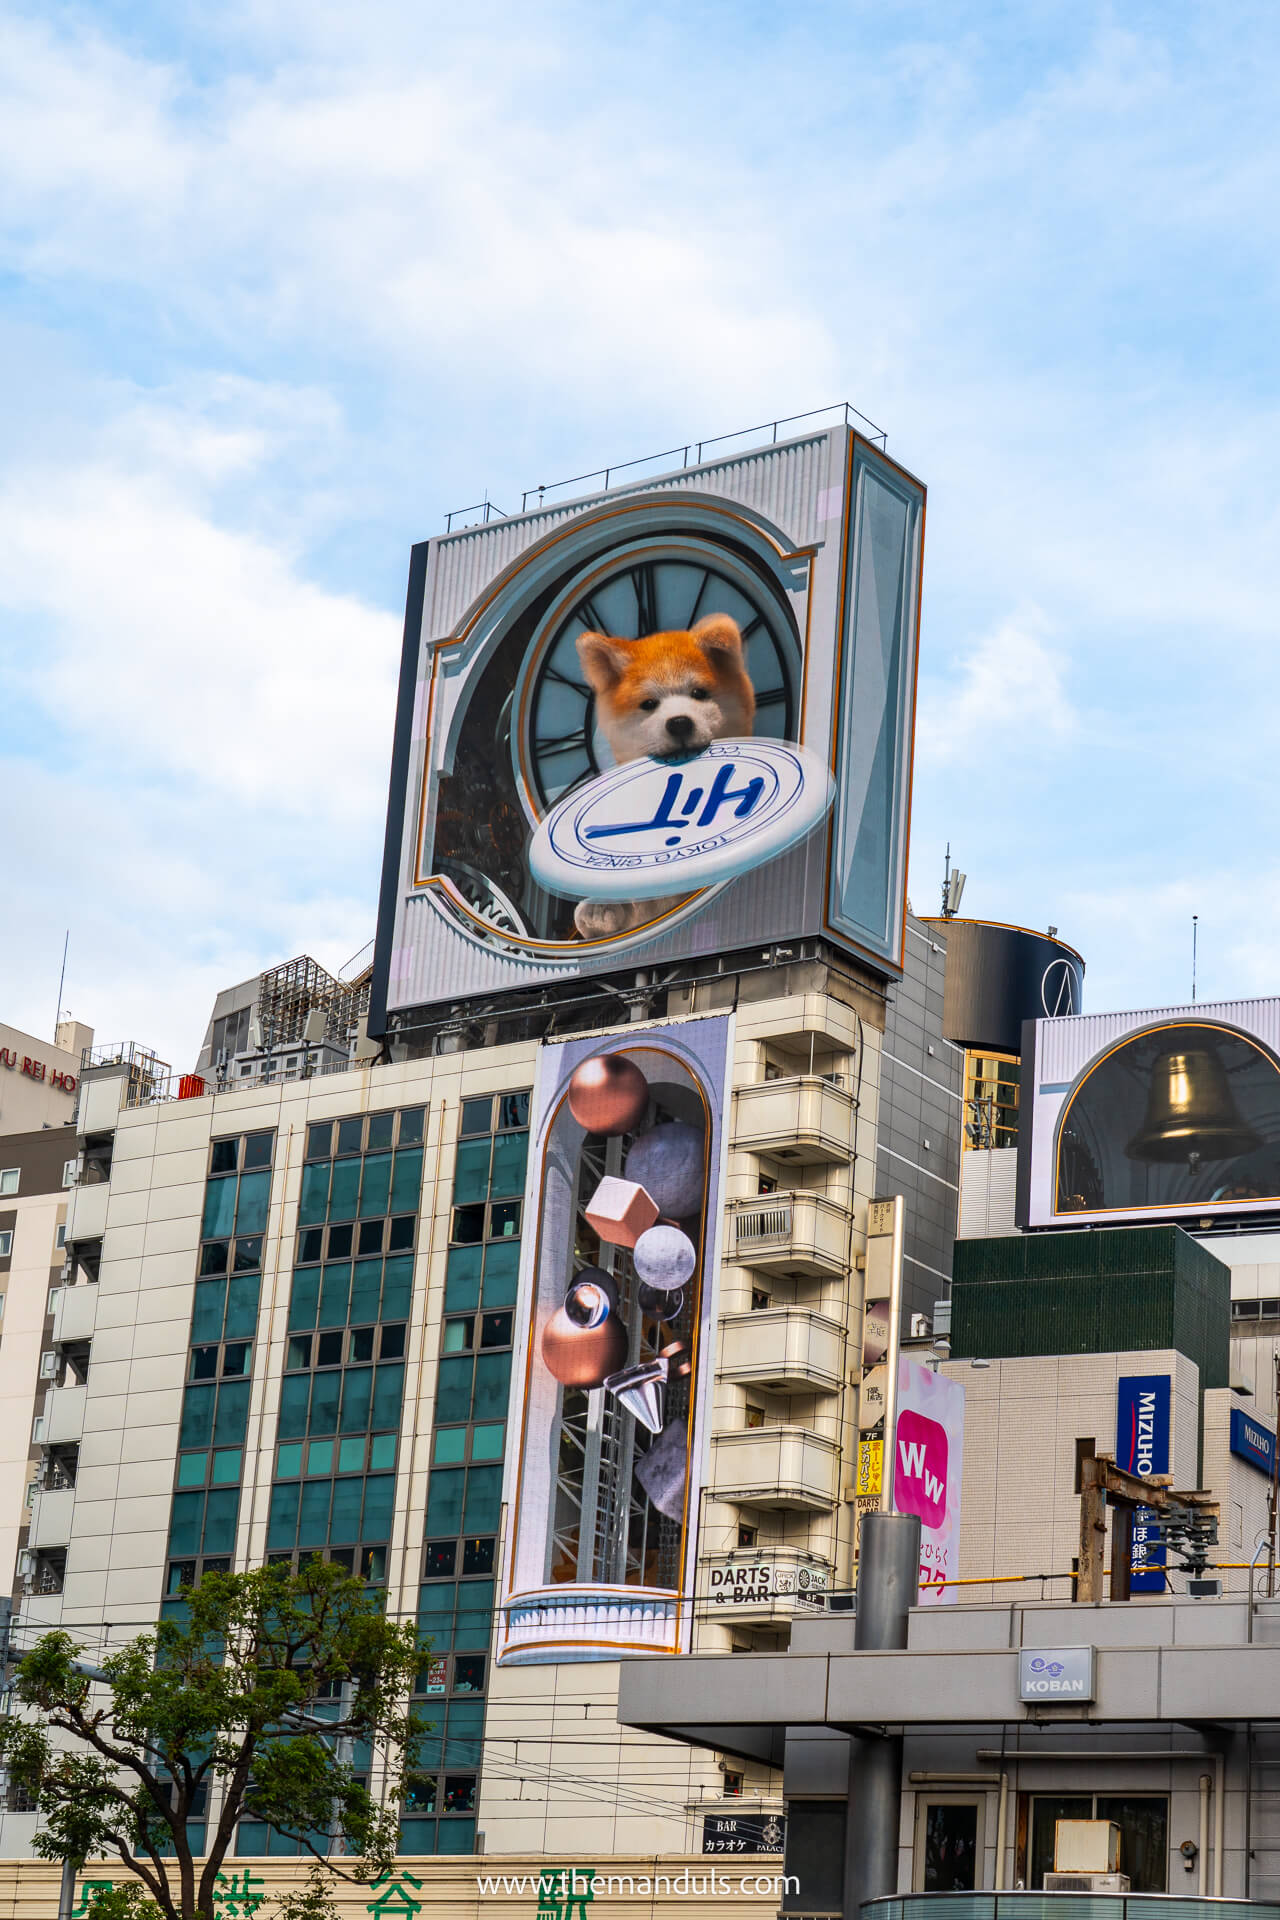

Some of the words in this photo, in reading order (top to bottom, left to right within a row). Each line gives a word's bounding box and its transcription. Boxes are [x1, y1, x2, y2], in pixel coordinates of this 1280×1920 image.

[655, 834, 732, 864] TOKYO
[22, 1055, 46, 1081] REI
[866, 1432, 878, 1440] 7F
[1137, 1392, 1156, 1476] MIZUHO
[1244, 1424, 1270, 1454] MIZUHO
[857, 1498, 880, 1508] DARTS
[711, 1566, 770, 1586] DARTS
[811, 1574, 826, 1586] JACK
[715, 1591, 726, 1604] &
[733, 1585, 769, 1603] BAR
[1025, 1679, 1084, 1692] KOBAN
[768, 1815, 778, 1823] 4F
[716, 1820, 737, 1832] BAR
[704, 1839, 747, 1852] カラオケ
